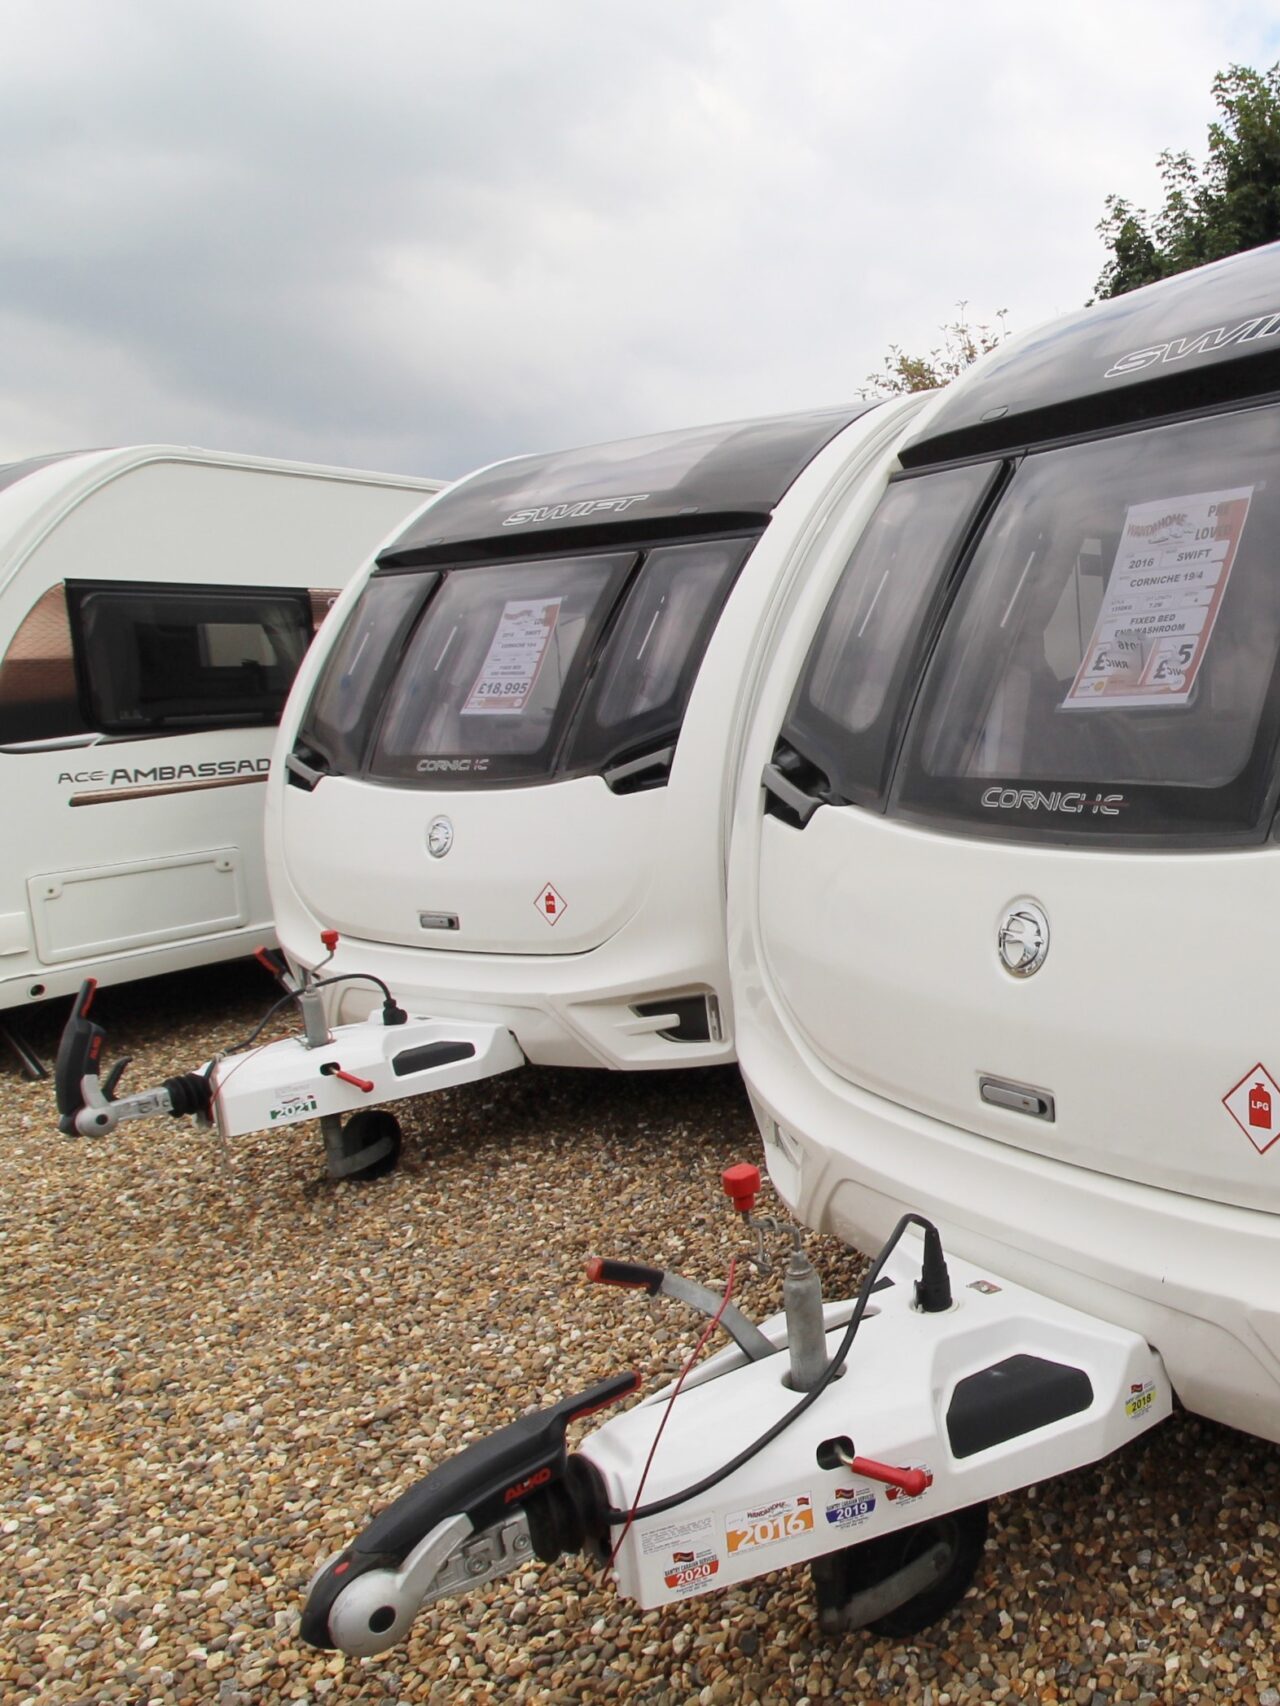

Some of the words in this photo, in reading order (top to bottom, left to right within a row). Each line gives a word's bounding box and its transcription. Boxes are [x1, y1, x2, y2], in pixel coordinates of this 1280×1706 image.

[503, 494, 650, 526] SWIFT
[1128, 558, 1155, 570] 2016
[1177, 548, 1213, 562] SWIFT
[1130, 573, 1181, 588] CORNICHE
[1130, 615, 1157, 625] FIXED
[1158, 613, 1176, 623] BED
[477, 682, 529, 697] £18,995
[58, 770, 109, 785] ACE
[110, 758, 271, 785] AMBASSAD
[981, 786, 1128, 815] CORNICHE
[276, 1101, 313, 1119] 2021
[1251, 1100, 1270, 1112] LPG
[1131, 1393, 1152, 1412] 2018
[836, 1502, 868, 1520] 2019
[737, 1511, 806, 1551] 2016
[676, 1564, 711, 1584] 2020
